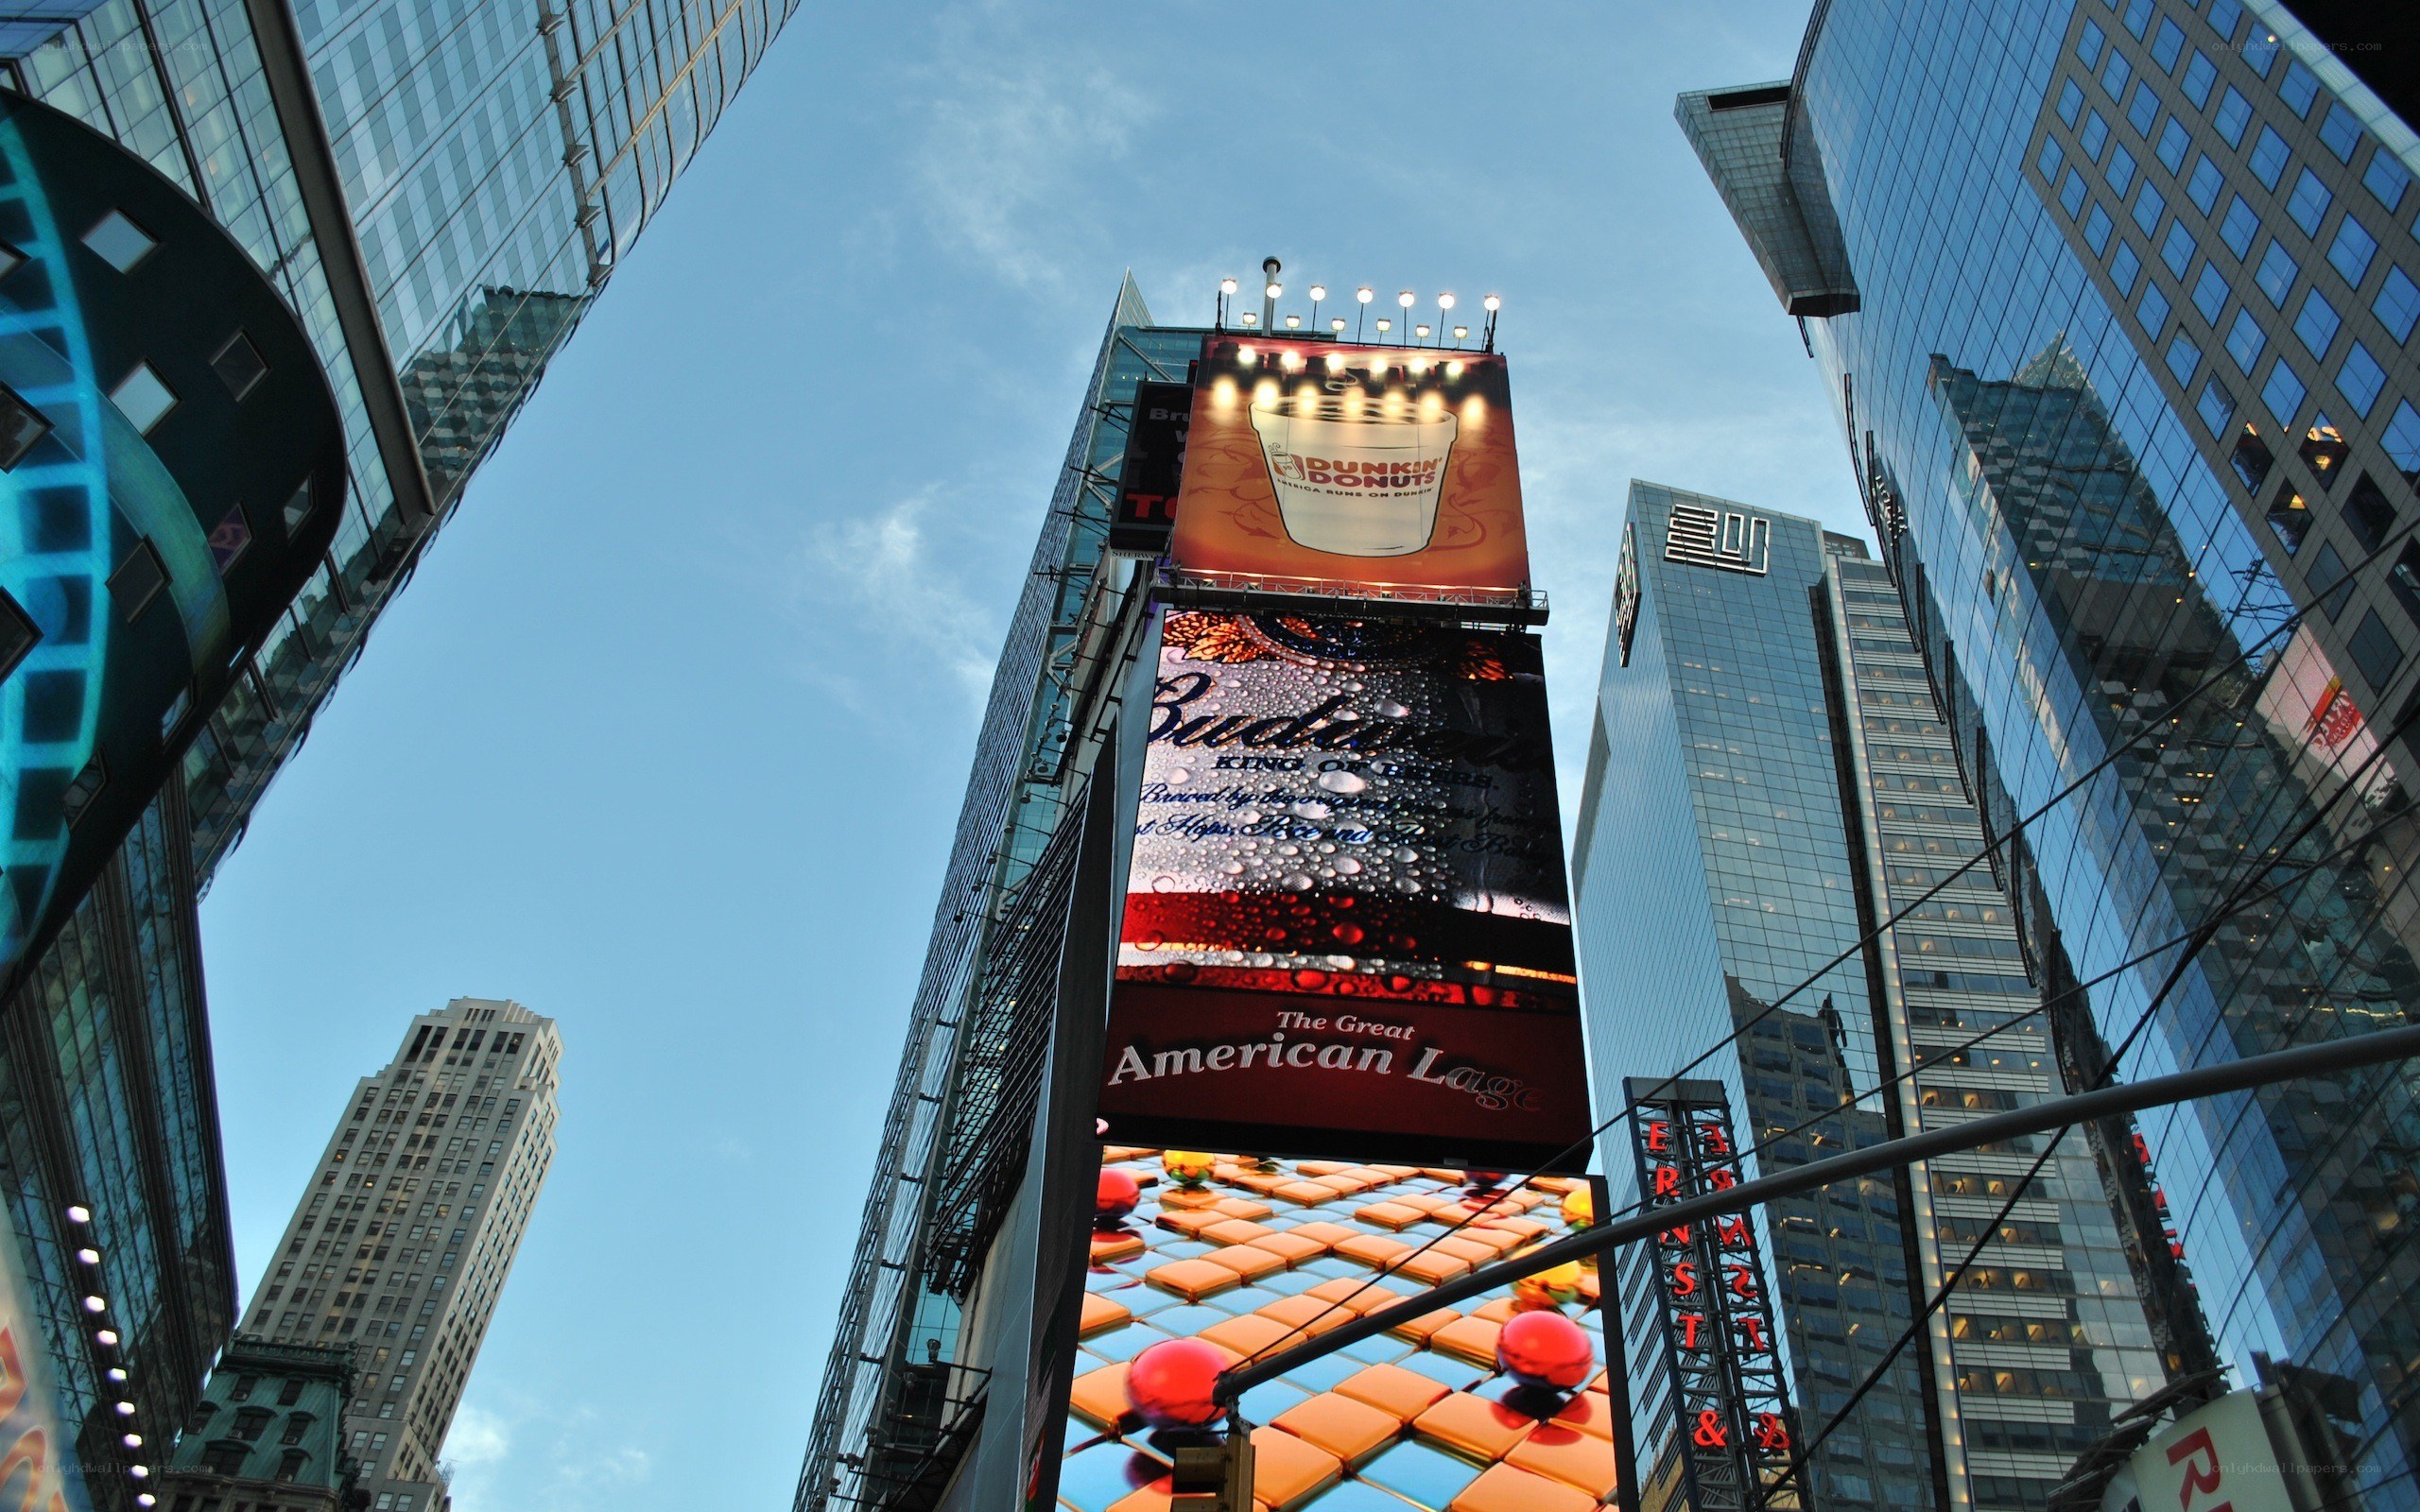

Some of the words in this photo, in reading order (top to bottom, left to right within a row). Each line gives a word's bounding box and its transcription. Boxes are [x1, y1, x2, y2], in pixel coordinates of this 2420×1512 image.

[1277, 477, 1321, 493] AMERICA
[1307, 471, 1436, 489] DONUTS
[1211, 756, 1305, 771] KING
[1318, 759, 1371, 773] OF
[1276, 1010, 1327, 1032] The
[1335, 1014, 1416, 1040] Great
[1107, 1032, 1392, 1087] American
